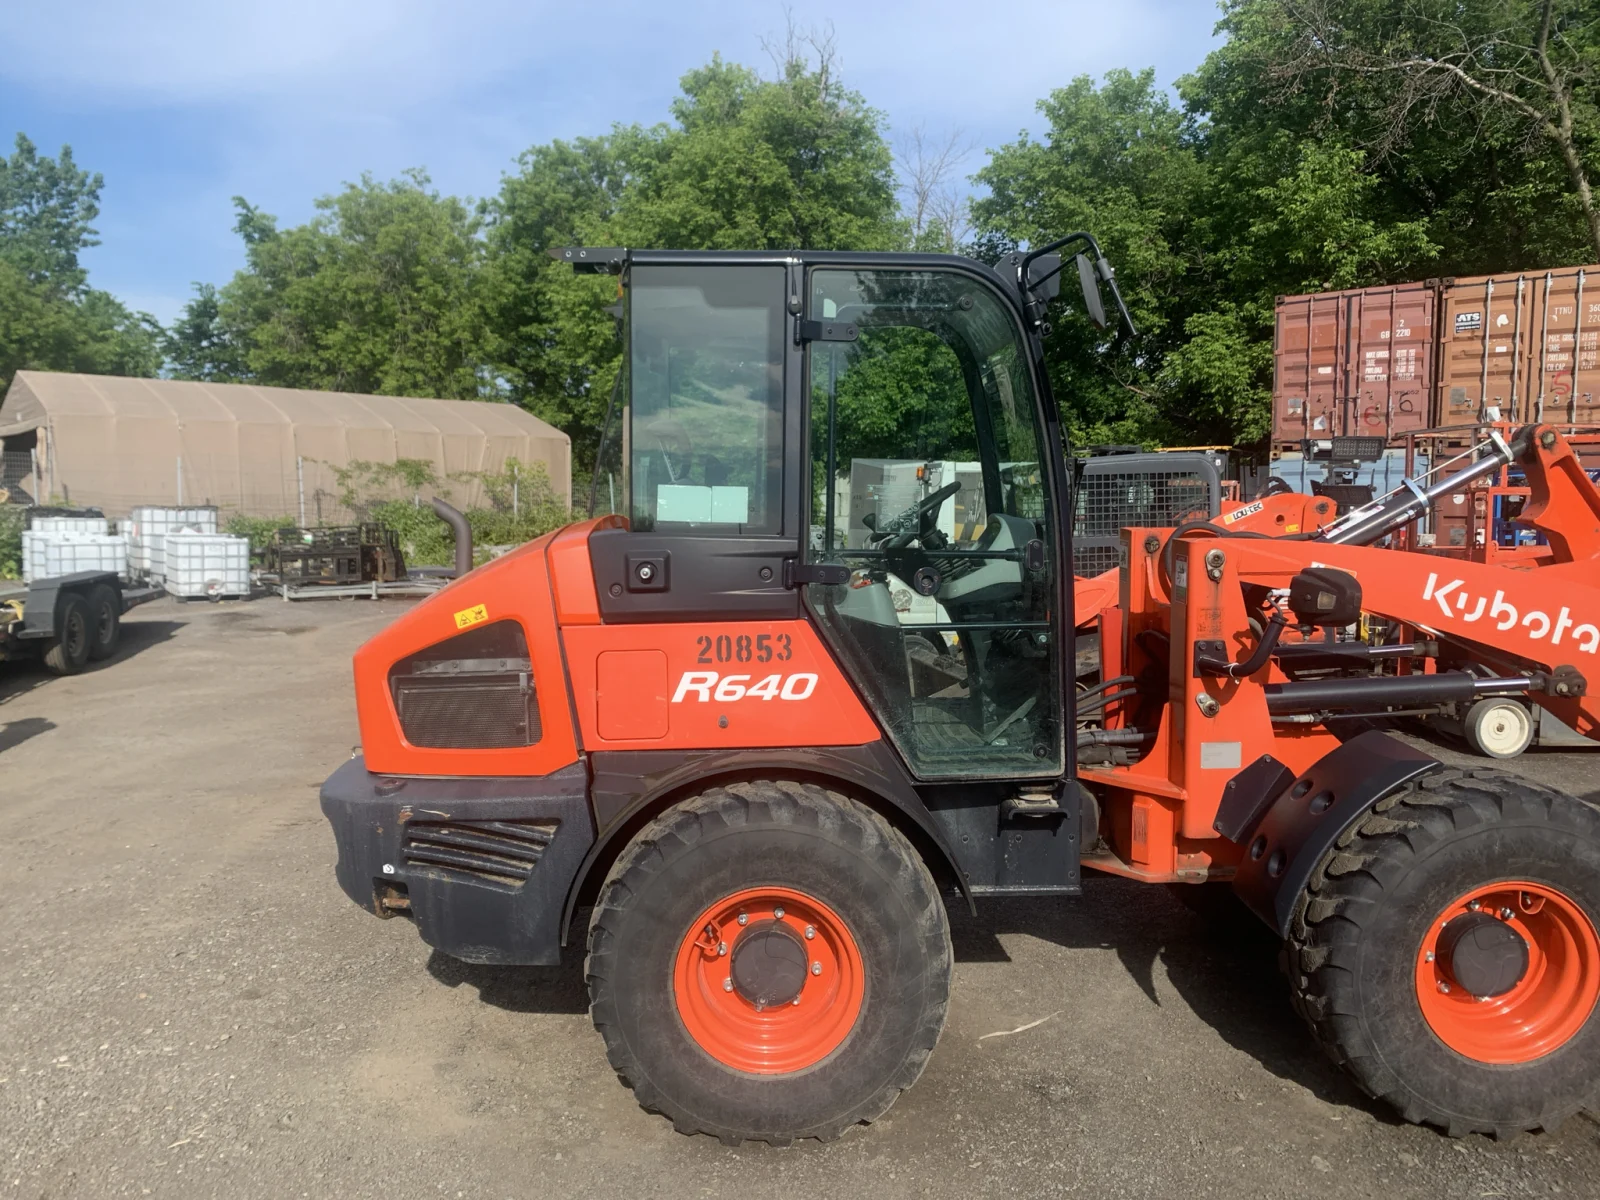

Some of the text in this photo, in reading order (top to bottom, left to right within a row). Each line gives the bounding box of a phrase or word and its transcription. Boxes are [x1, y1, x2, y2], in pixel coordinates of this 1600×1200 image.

[1457, 313, 1480, 322] ATS
[1422, 572, 1600, 655] Kubota
[696, 633, 793, 664] 20853
[671, 671, 819, 703] R640
